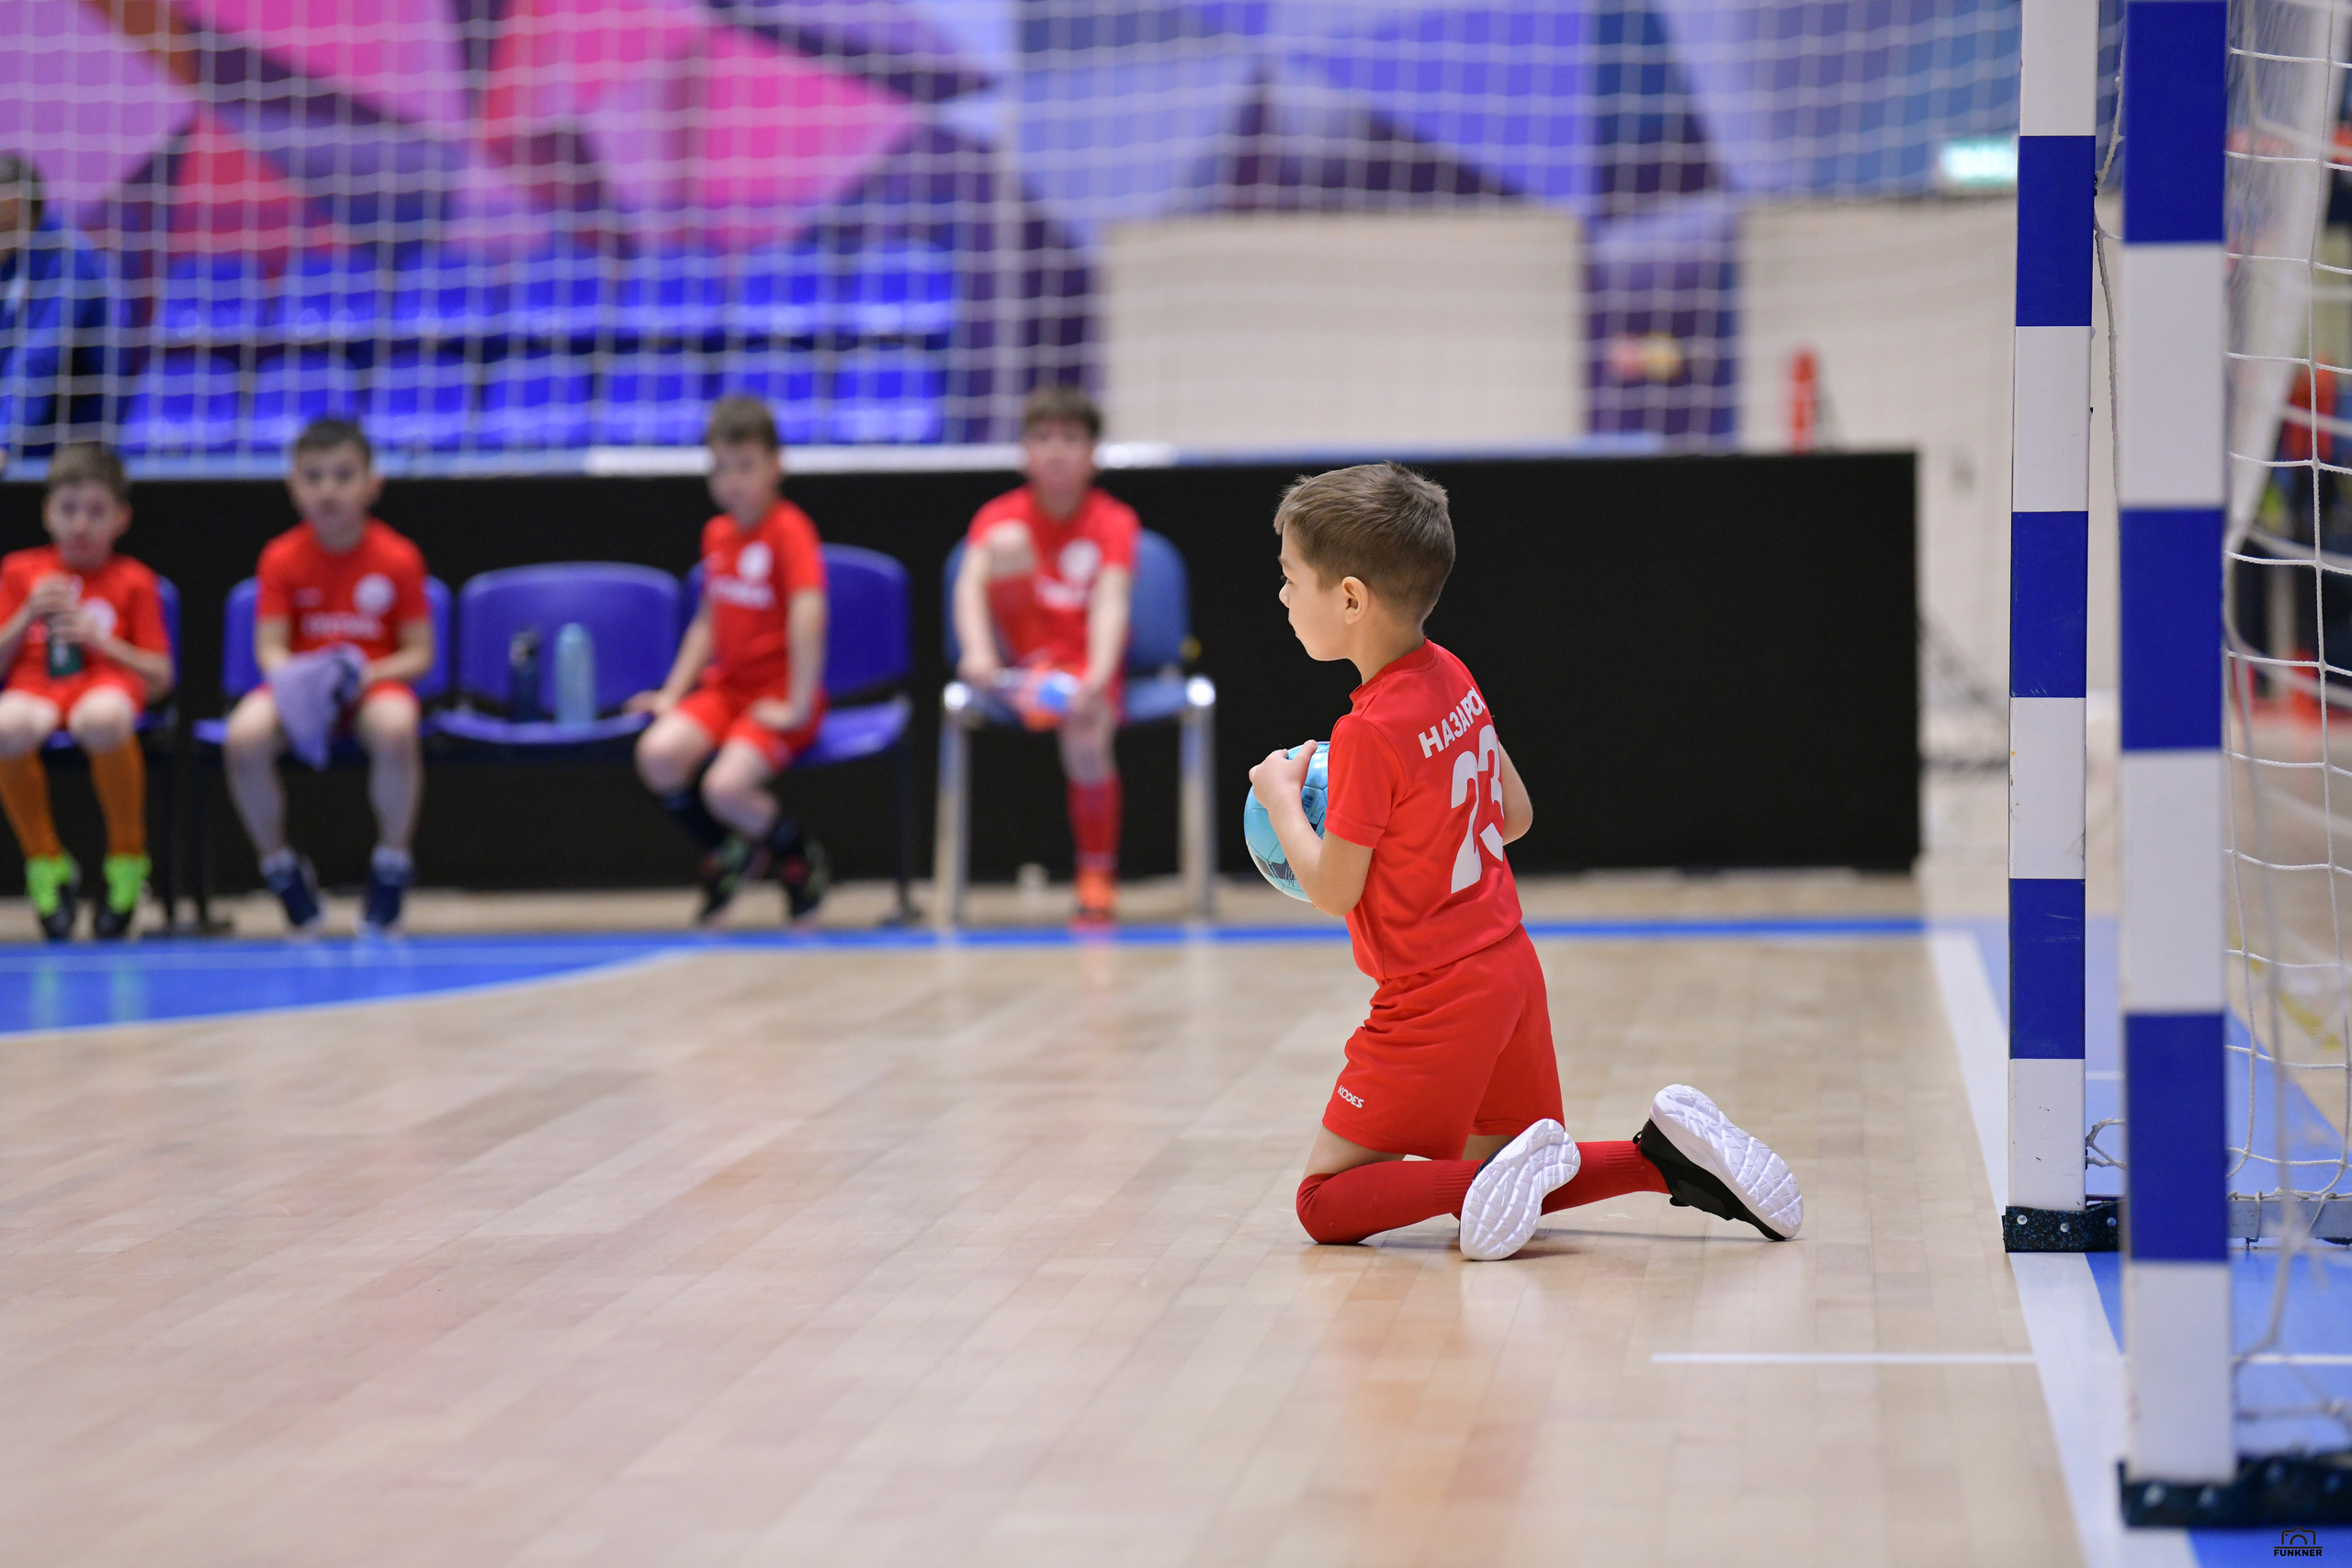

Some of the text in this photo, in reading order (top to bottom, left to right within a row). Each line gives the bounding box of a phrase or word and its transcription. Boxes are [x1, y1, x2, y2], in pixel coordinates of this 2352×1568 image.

[1418, 686, 1487, 759] НАЗАРО
[1451, 724, 1505, 895] 23
[1337, 1085, 1365, 1109] KODES
